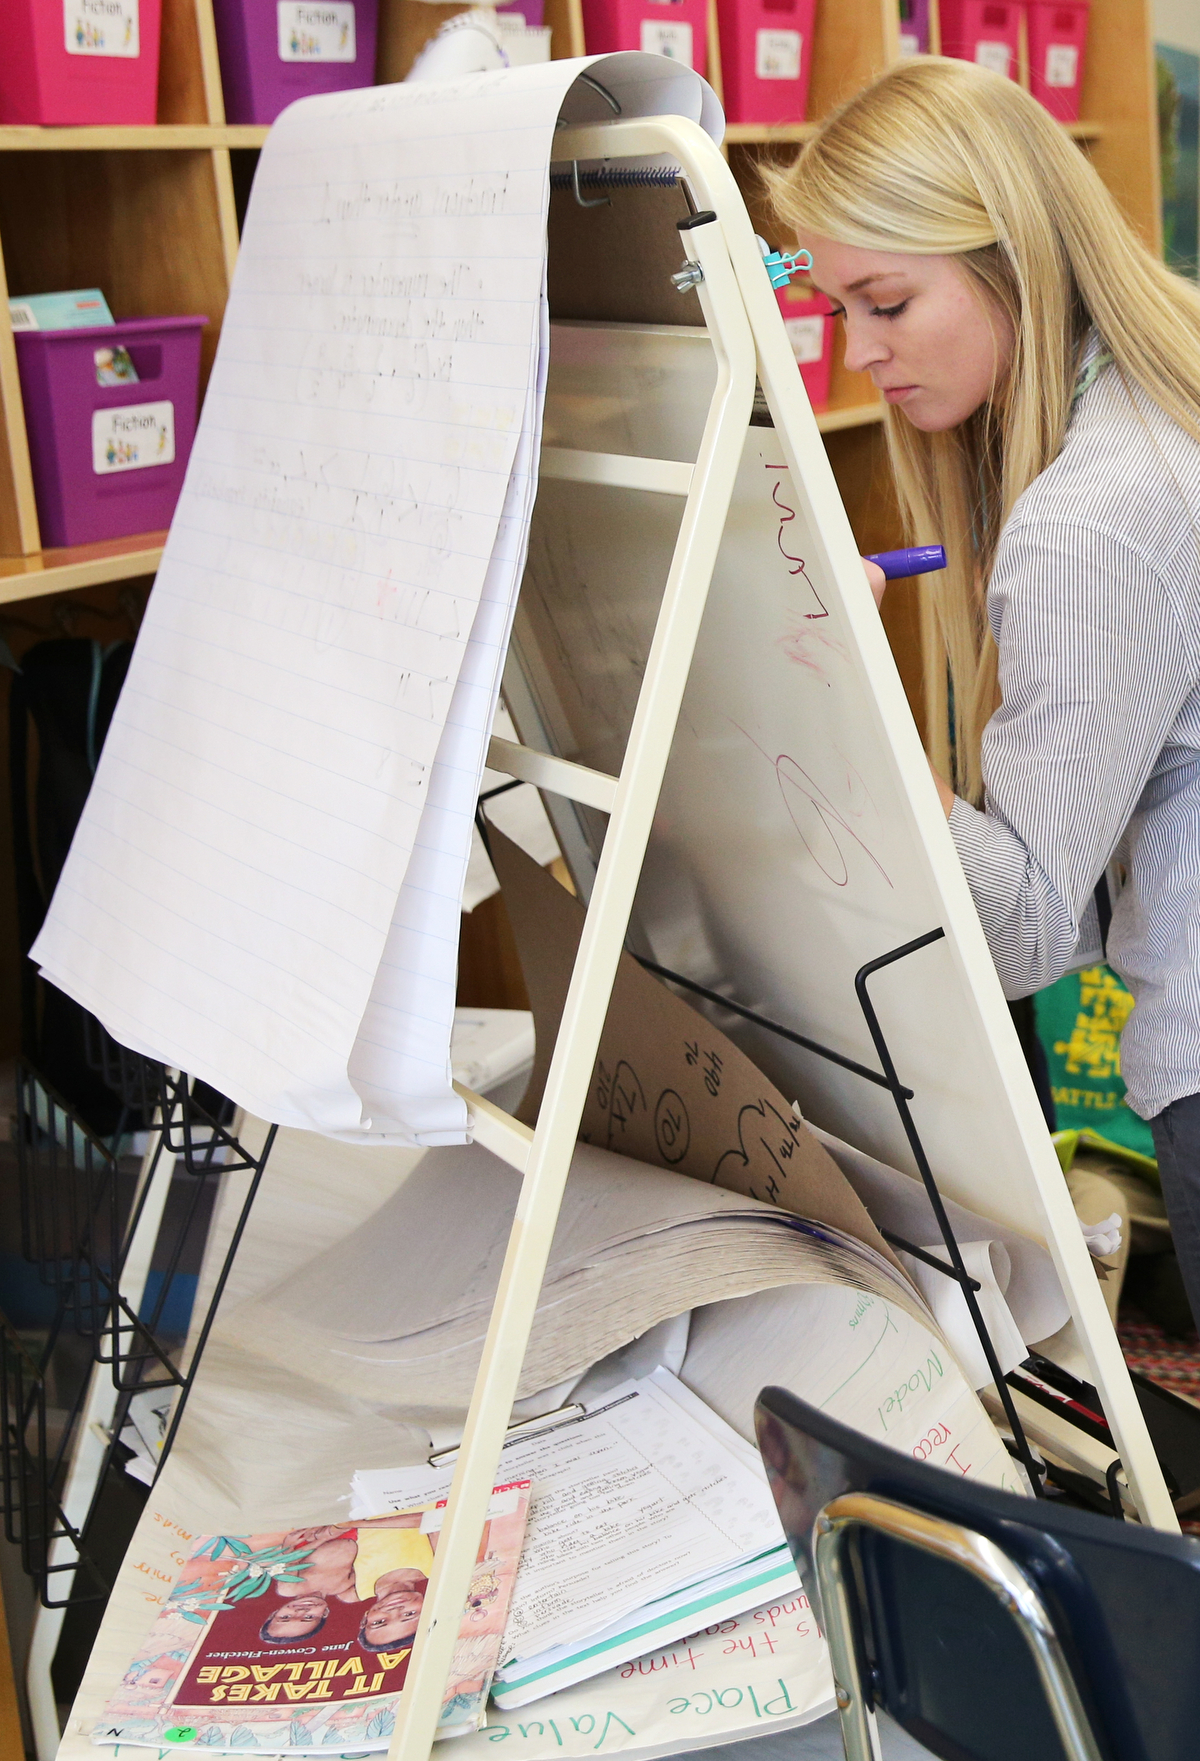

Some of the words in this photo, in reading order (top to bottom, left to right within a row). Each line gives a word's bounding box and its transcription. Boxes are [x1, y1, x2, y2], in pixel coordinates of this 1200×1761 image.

[297, 6, 338, 25] Fiction
[112, 414, 156, 433] Fiction
[878, 1349, 944, 1431] Model
[205, 1647, 317, 1659] Cowen-Fletcher
[322, 1640, 354, 1651] Jane
[722, 1631, 779, 1658] the
[196, 1656, 364, 1684] VILLAGE
[376, 1648, 413, 1670] A
[616, 1648, 704, 1679] time
[209, 1680, 334, 1702] TAKES
[343, 1672, 386, 1696] IT
[667, 1678, 799, 1718] Place
[480, 1711, 636, 1750] Value
